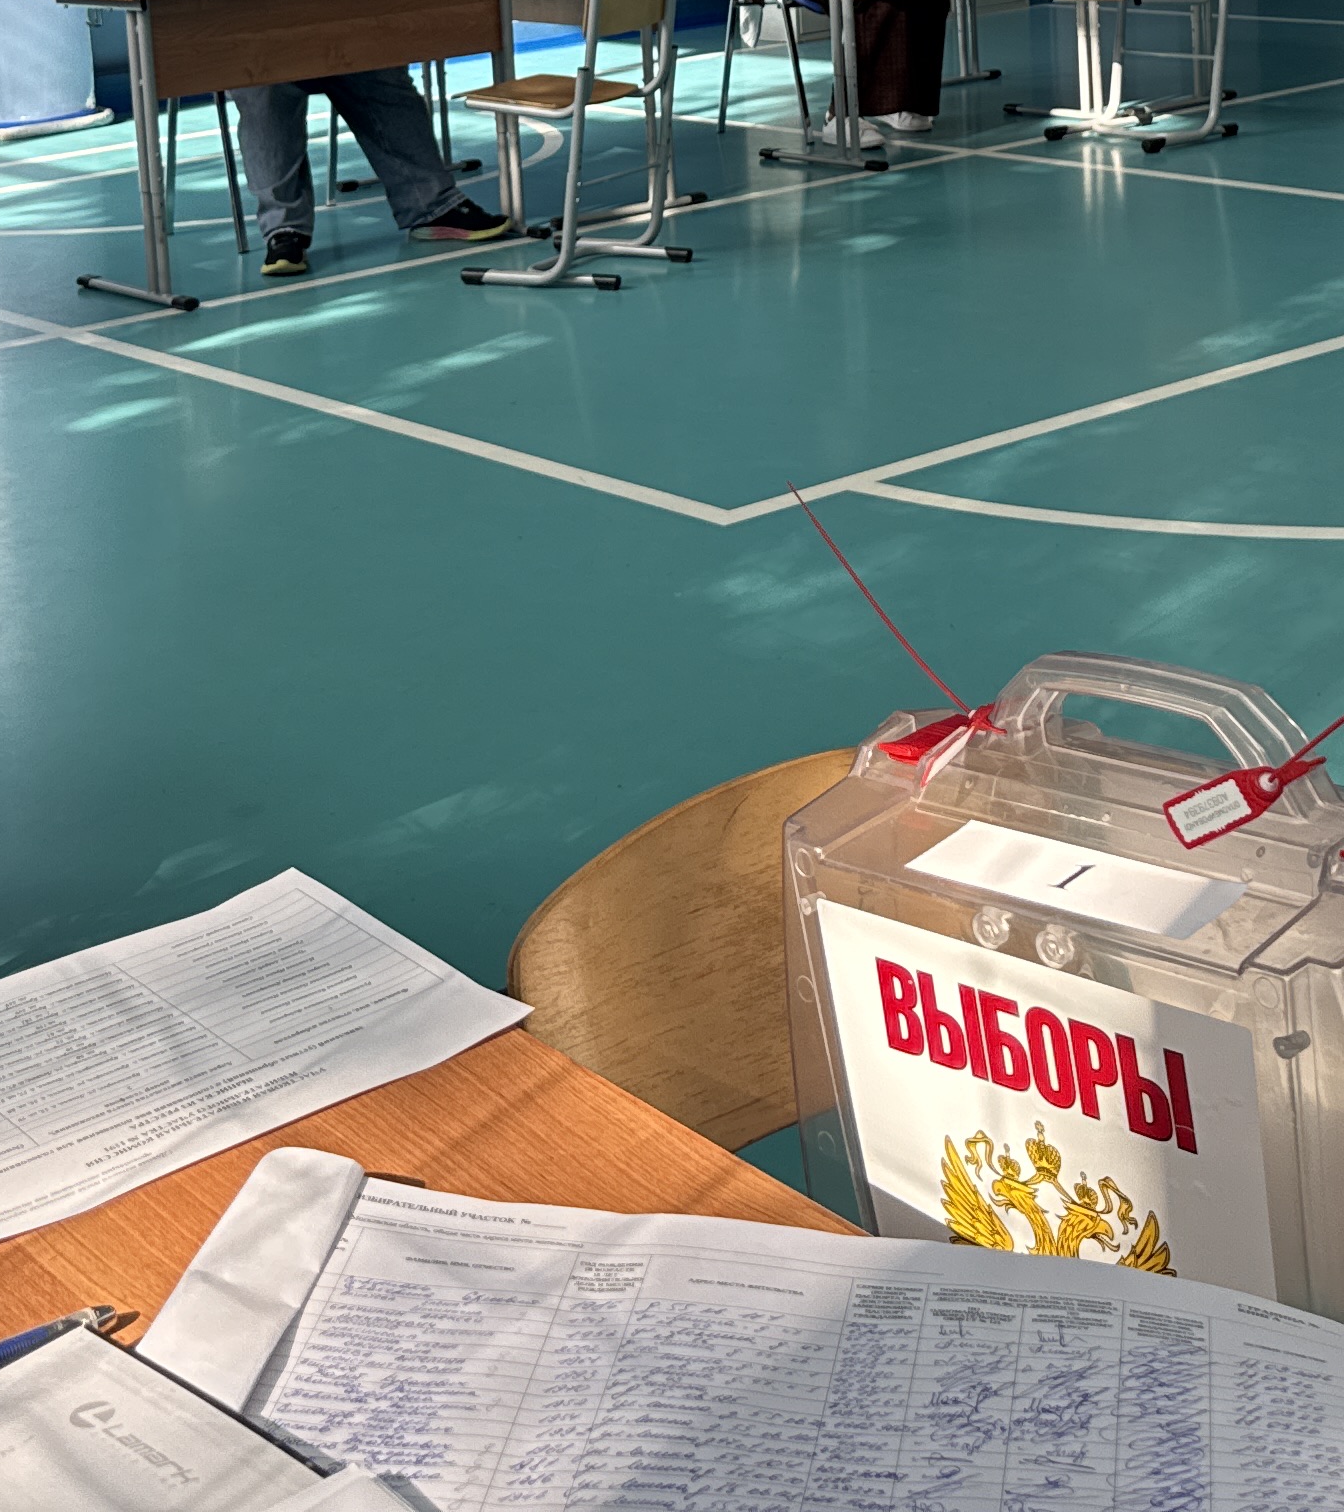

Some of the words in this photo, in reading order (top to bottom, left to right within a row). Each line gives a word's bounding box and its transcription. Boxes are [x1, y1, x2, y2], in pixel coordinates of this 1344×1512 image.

[1047, 864, 1096, 890] 1
[875, 956, 1199, 1155] ВЫБОРЫ
[460, 1210, 516, 1225] УЧАСТОК
[100, 1423, 200, 1485] Lamark
